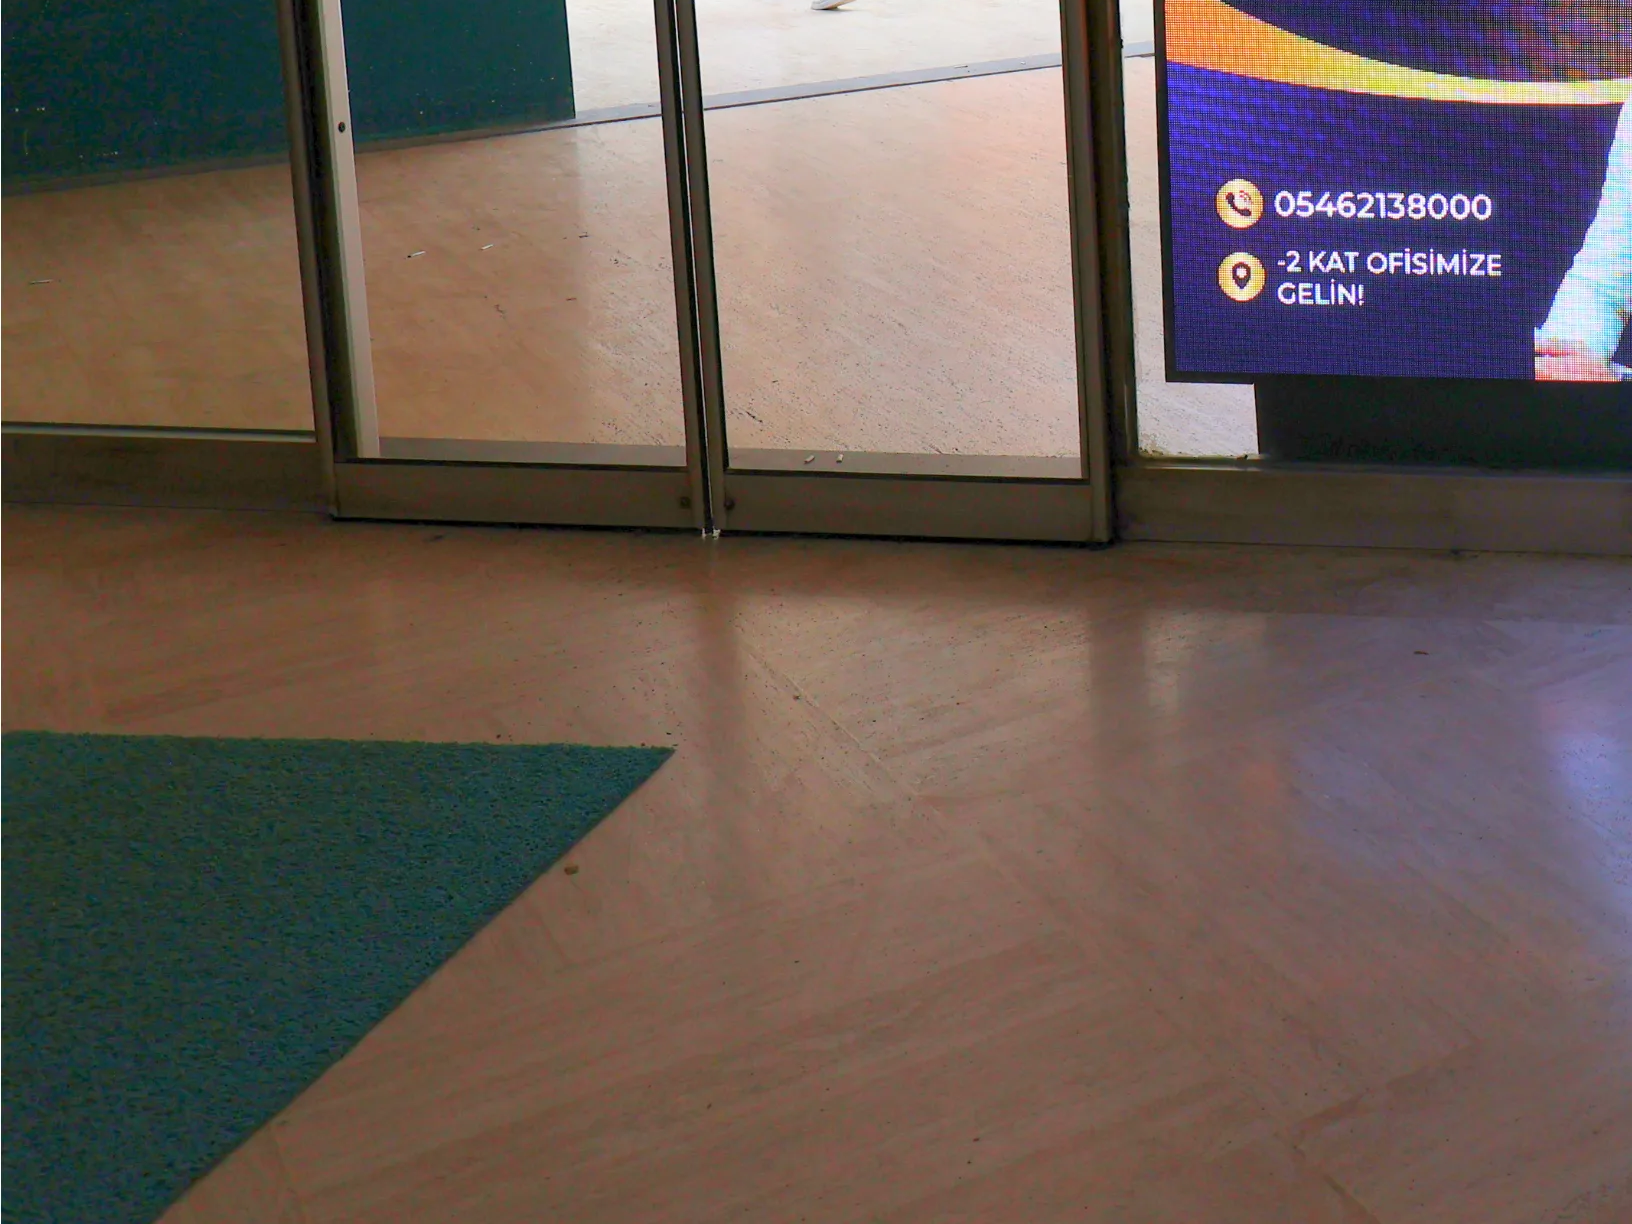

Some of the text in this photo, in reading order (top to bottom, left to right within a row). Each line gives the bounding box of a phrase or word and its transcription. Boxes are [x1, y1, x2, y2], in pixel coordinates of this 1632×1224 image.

[1273, 190, 1493, 221] 05462138000
[1277, 247, 1502, 277] -2 KAT OFİSİMİZE
[1276, 278, 1365, 306] GELİN!
